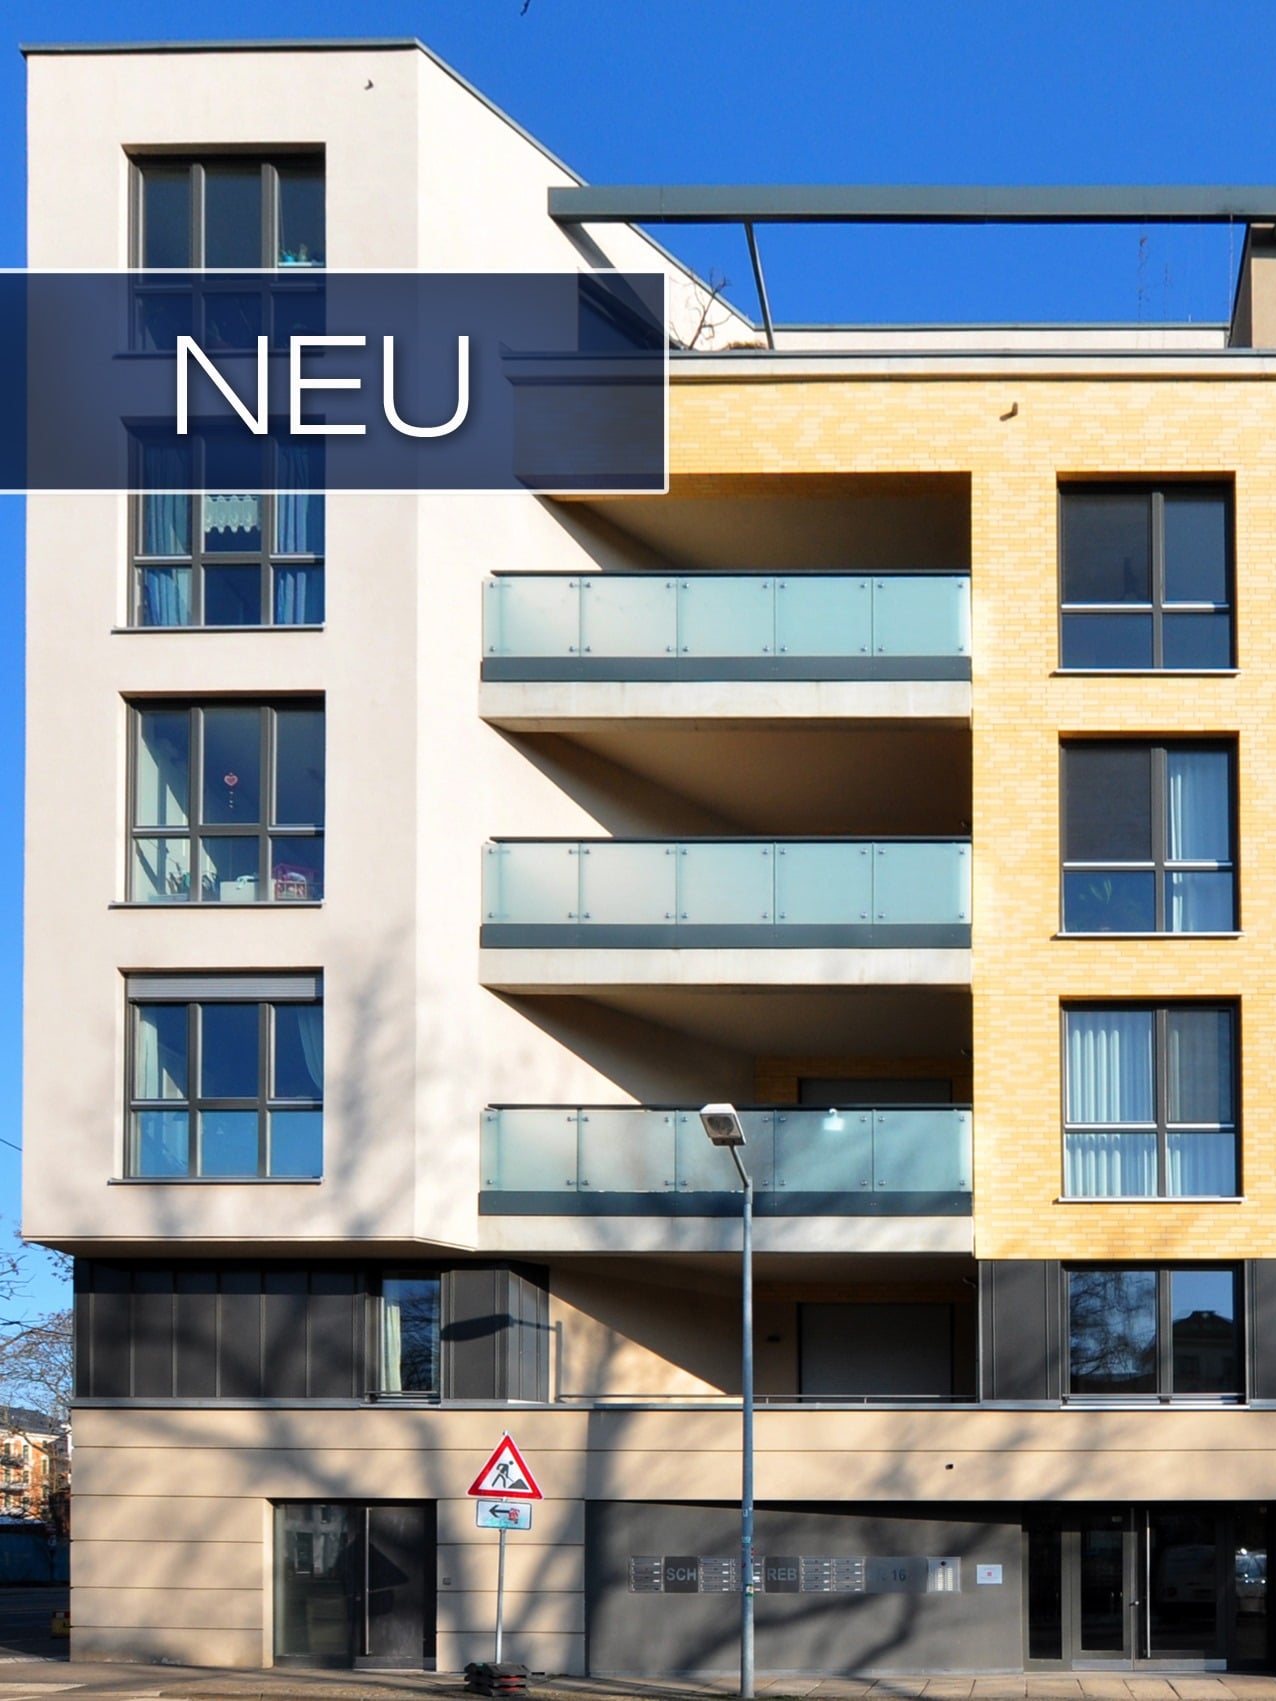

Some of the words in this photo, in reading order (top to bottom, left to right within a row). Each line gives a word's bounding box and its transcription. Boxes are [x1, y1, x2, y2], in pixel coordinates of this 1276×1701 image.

[665, 1567, 697, 1581] SCH
[766, 1567, 798, 1581] REB
[891, 1567, 908, 1582] 16
